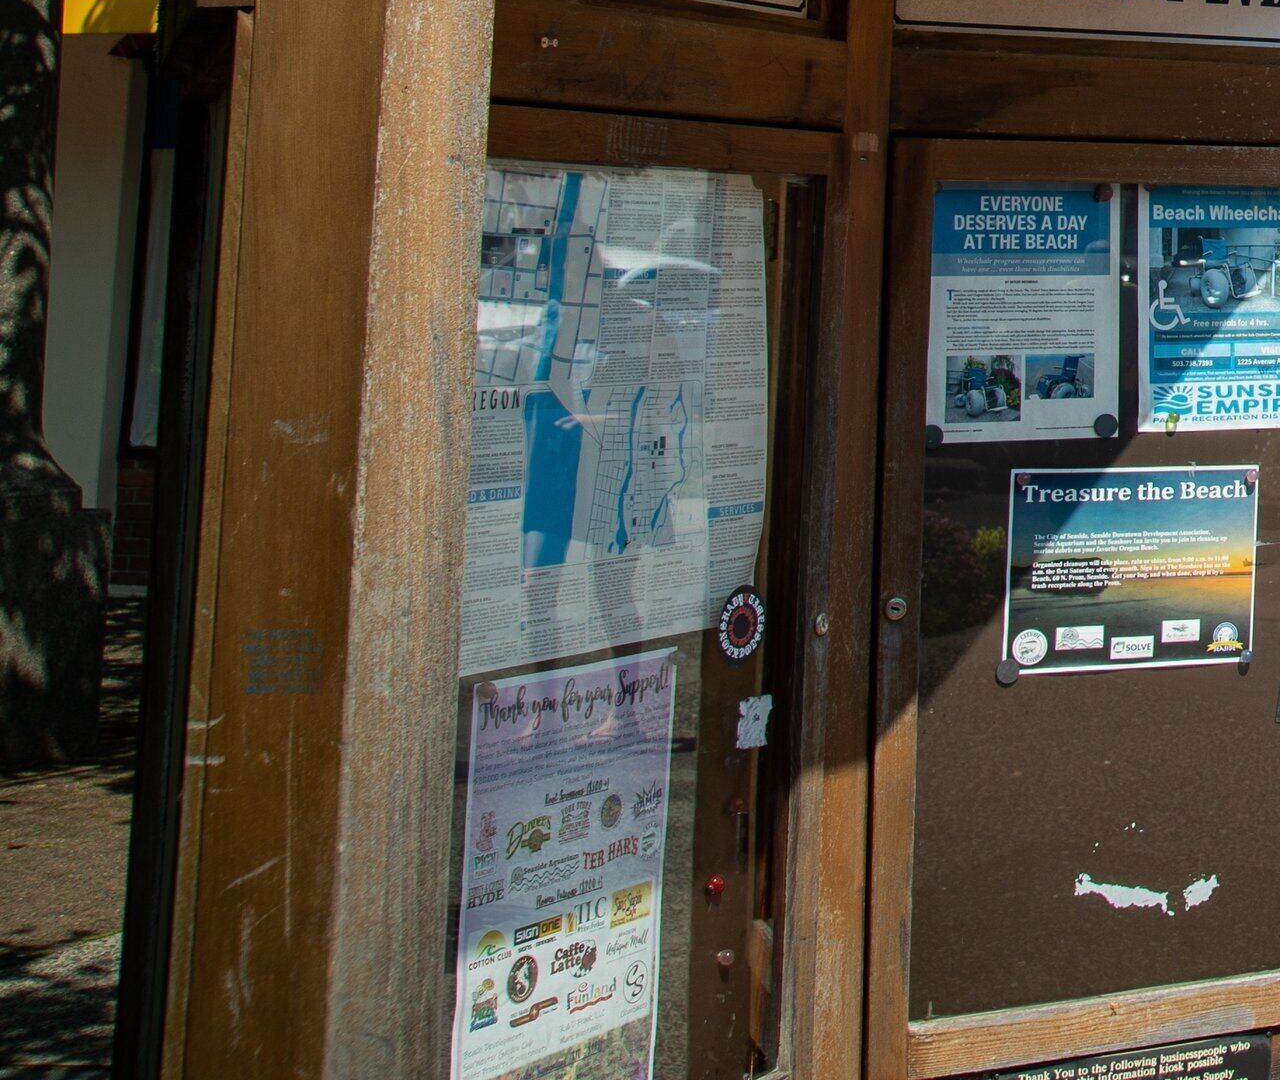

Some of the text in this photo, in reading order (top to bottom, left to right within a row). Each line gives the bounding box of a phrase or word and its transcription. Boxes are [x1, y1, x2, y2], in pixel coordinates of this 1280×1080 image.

[980, 195, 1063, 211] EVERYONE
[1152, 204, 1205, 221] Beach
[954, 214, 1088, 231] DESERVES A DAY
[963, 234, 1078, 249] AT THE BEACH
[957, 256, 993, 265] Wheelchair
[994, 258, 1021, 267] program
[1046, 258, 1073, 267] everyone
[1048, 265, 1080, 273] disabilities
[1193, 319, 1210, 327] Free
[1212, 319, 1236, 327] rentals
[1238, 318, 1248, 327] for
[1256, 318, 1270, 327] hrs.
[1237, 358, 1252, 366] 1225
[1253, 358, 1276, 366] Avenue
[480, 490, 488, 502] &
[490, 486, 521, 500] DRINK
[1021, 479, 1249, 503] Treasure the Beach
[720, 503, 756, 516] SERVICES
[1142, 530, 1178, 538] Development
[1126, 642, 1152, 652] SOLVE
[478, 662, 670, 731] Thank you for your Support!
[582, 835, 640, 870] TER HAR'S
[524, 854, 580, 875] Seaside Aquarium
[466, 889, 505, 909] HYDE
[576, 896, 608, 924] TLC
[555, 942, 586, 961] Caffe
[468, 949, 512, 972] COTTON CLUB
[550, 954, 582, 975] Latte
[566, 977, 618, 1010] Funland
[1018, 1040, 1250, 1080] Thank You to the following businesspeople who
[1098, 1068, 1156, 1080] information
[1159, 1062, 1184, 1074] kiosk
[1187, 1056, 1224, 1072] possible
[1203, 1069, 1234, 1080] Supply
